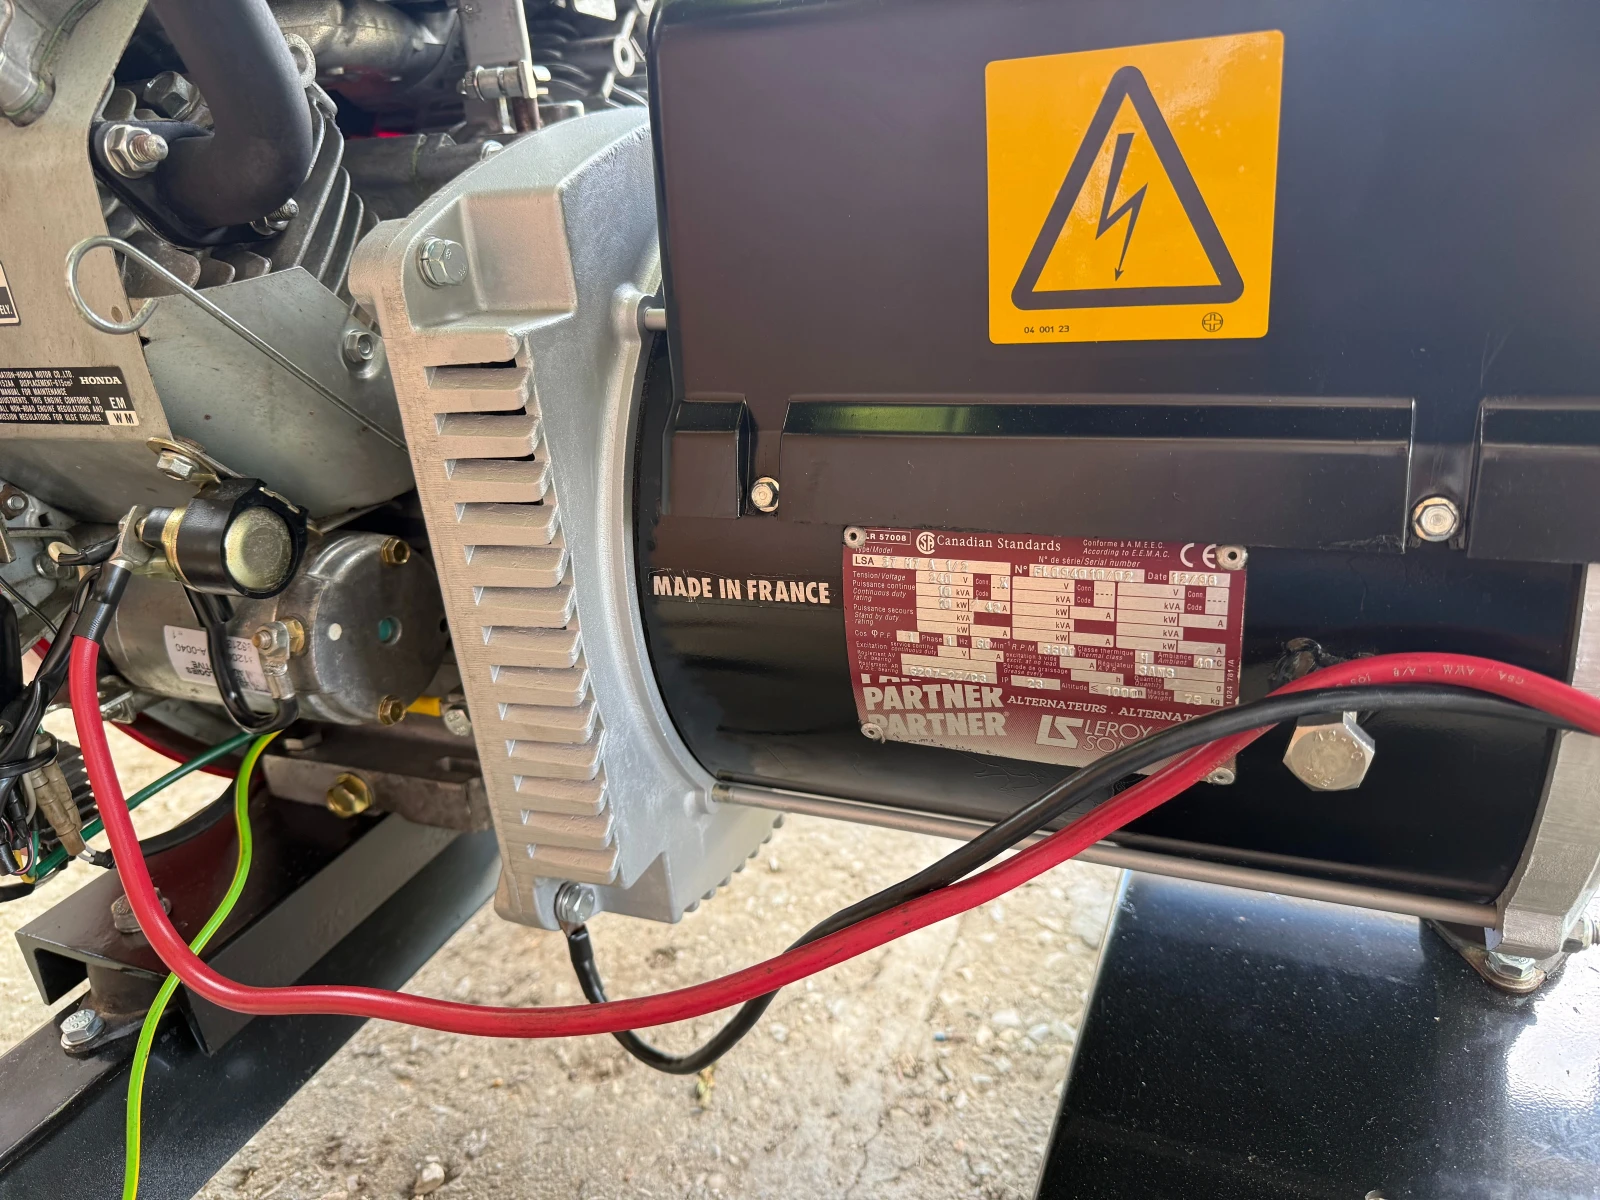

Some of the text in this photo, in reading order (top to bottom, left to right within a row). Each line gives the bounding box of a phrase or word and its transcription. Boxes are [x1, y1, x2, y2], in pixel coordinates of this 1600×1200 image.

[1023, 326, 1035, 334] 04
[1058, 325, 1070, 333] 23
[79, 376, 122, 385] HONDA
[109, 397, 127, 409] EM
[879, 534, 907, 542] 57008
[937, 535, 1061, 551] Canadian Standards
[1083, 539, 1118, 548] Conforme
[1083, 548, 1119, 556] According
[855, 556, 874, 566] LSA
[1109, 558, 1140, 568] number
[1147, 572, 1167, 581] Date
[653, 576, 831, 604] MADE IN FRANCE
[852, 580, 916, 591] Puissance continue
[1064, 582, 1069, 590] V
[853, 587, 907, 599] Continuous duty
[956, 589, 970, 597] kVA
[853, 594, 872, 602] rating
[1055, 595, 1071, 603] kVA
[853, 603, 914, 615] Puissance secours
[956, 601, 967, 609] kW
[1002, 604, 1007, 612] A
[1164, 602, 1181, 610] kVA
[1055, 608, 1067, 616] kW
[854, 611, 900, 623] Stand by duty
[957, 614, 971, 622] kVA
[1163, 616, 1176, 624] kW
[1055, 621, 1071, 629] kVA
[854, 629, 867, 637] Cos
[921, 634, 943, 643] Phase
[856, 641, 888, 650] Excitation
[1077, 646, 1134, 657] Classe thermique
[1158, 652, 1192, 660] Ambiance
[1216, 685, 1221, 693] g
[862, 683, 1004, 710] PARTNER
[1210, 697, 1220, 705] kg
[1007, 696, 1108, 714] ALTERNATEURS
[867, 712, 1008, 736] PARTNER
[1084, 719, 1152, 740] LEROY
